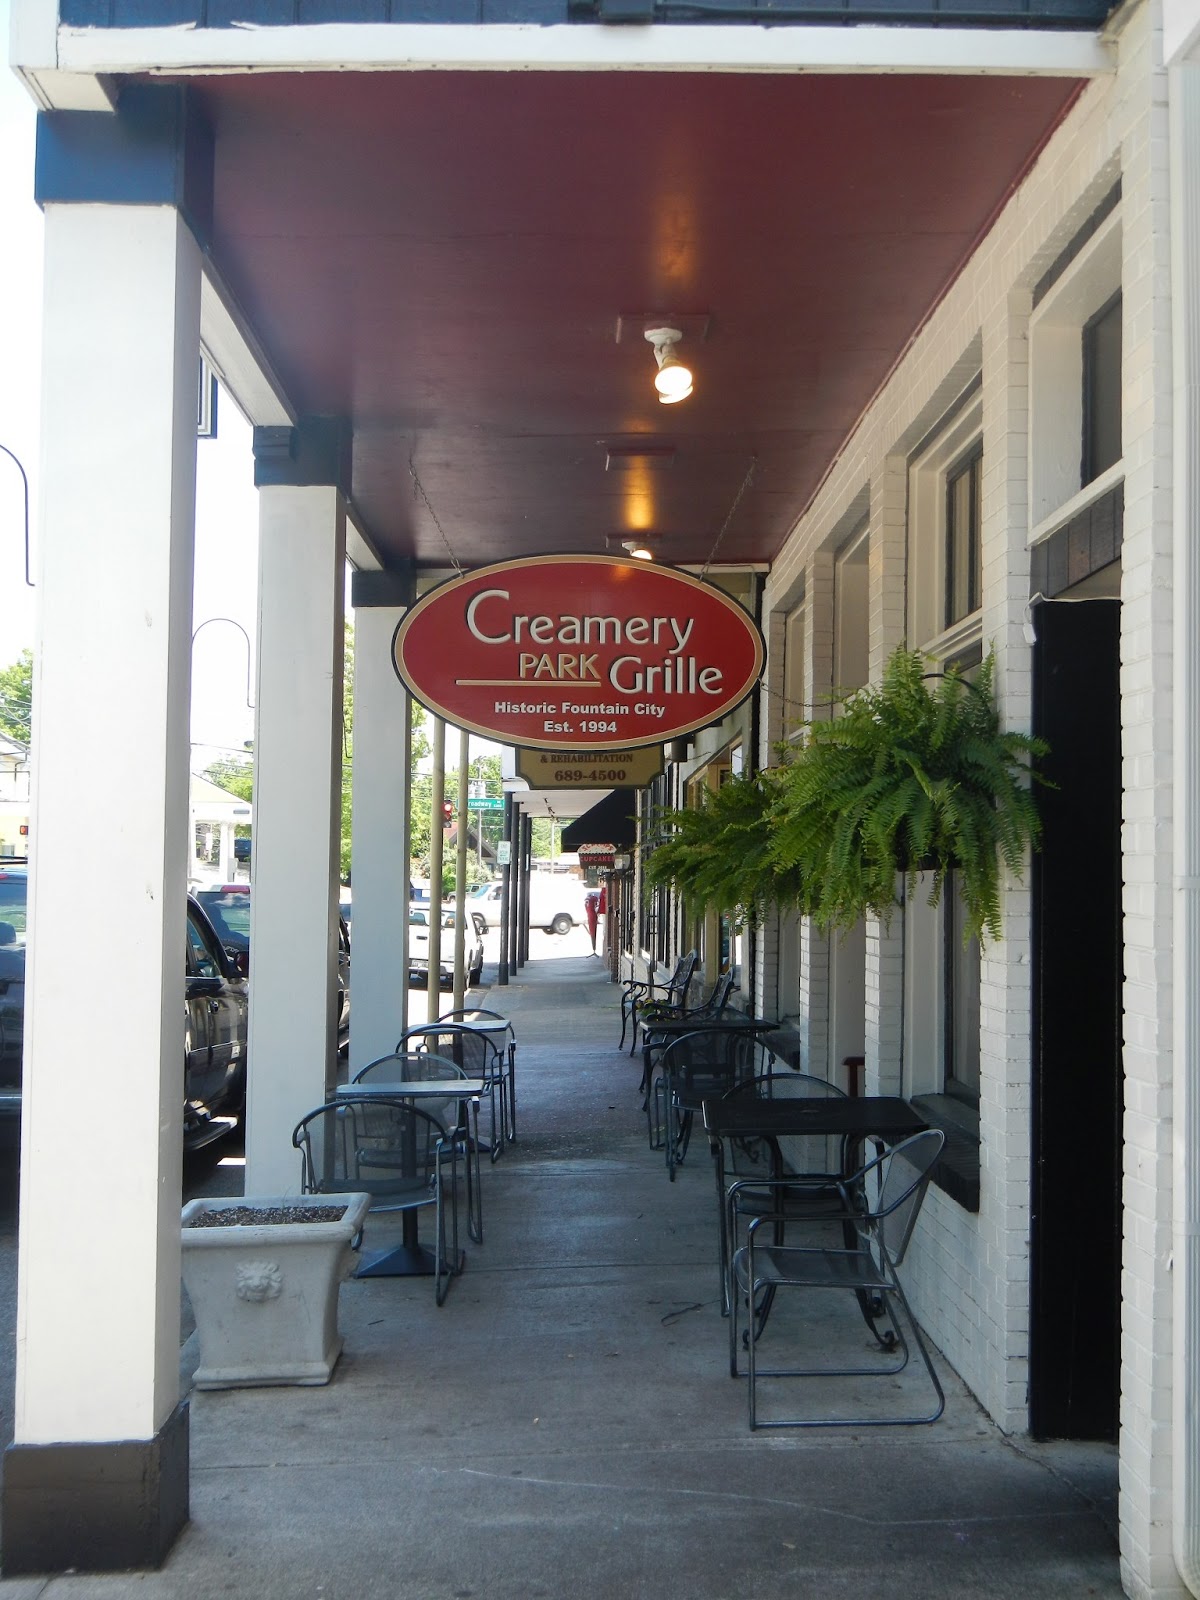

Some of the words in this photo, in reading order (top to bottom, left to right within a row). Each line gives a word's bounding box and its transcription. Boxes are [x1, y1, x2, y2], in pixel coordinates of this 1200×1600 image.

[466, 589, 694, 653] Creamery
[519, 653, 601, 679] PARK
[609, 656, 723, 695] Grille
[494, 702, 556, 714] Historic
[562, 702, 629, 715] Fountain
[634, 703, 666, 718] City
[544, 720, 574, 733] Est.
[579, 721, 617, 733] 1994
[540, 754, 548, 764] &
[550, 753, 633, 764] REHABILITATION
[554, 769, 626, 782] 689-4500
